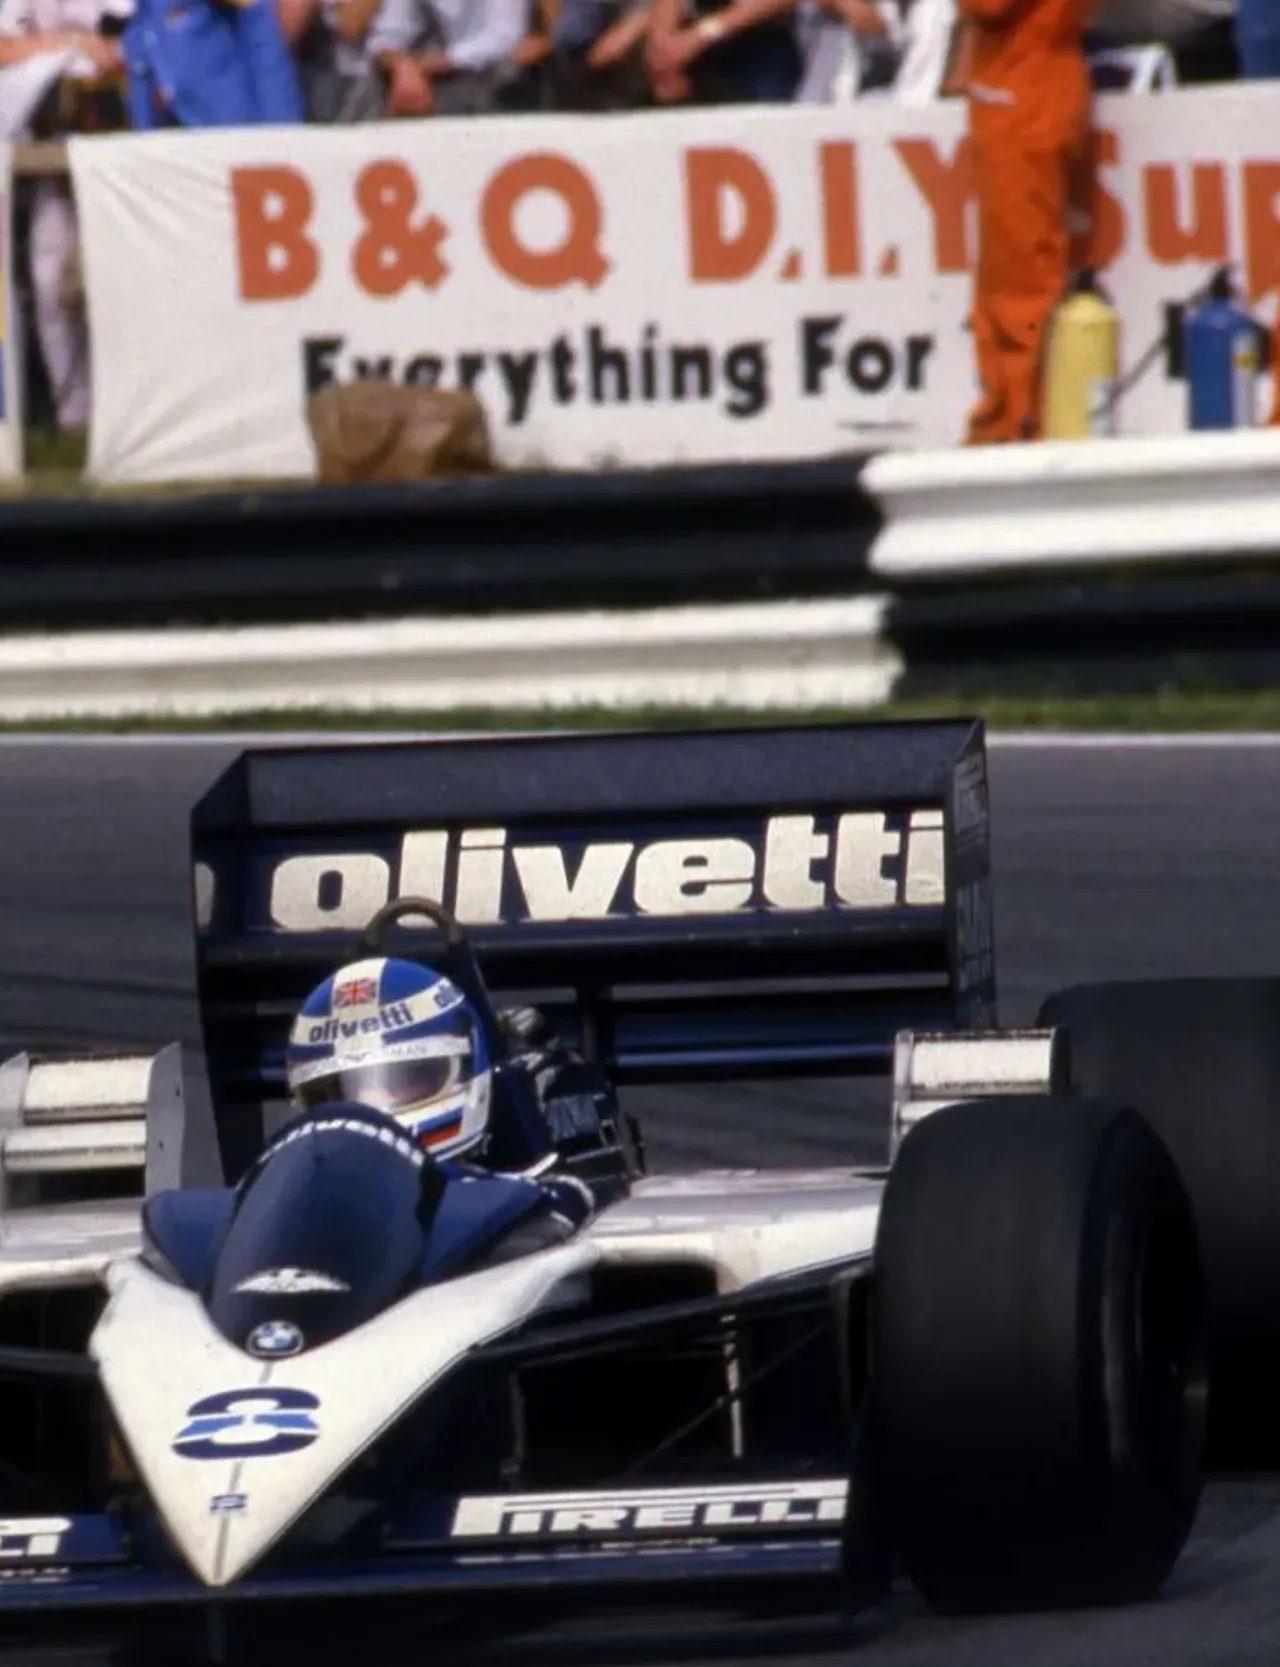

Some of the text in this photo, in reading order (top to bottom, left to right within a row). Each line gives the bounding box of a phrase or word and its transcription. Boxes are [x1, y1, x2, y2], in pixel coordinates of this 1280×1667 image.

[799, 313, 934, 396] For
[269, 810, 946, 931] olivetti
[308, 1002, 414, 1044] olivetti
[170, 1384, 321, 1462] 8
[450, 1479, 850, 1538] PIRELLI
